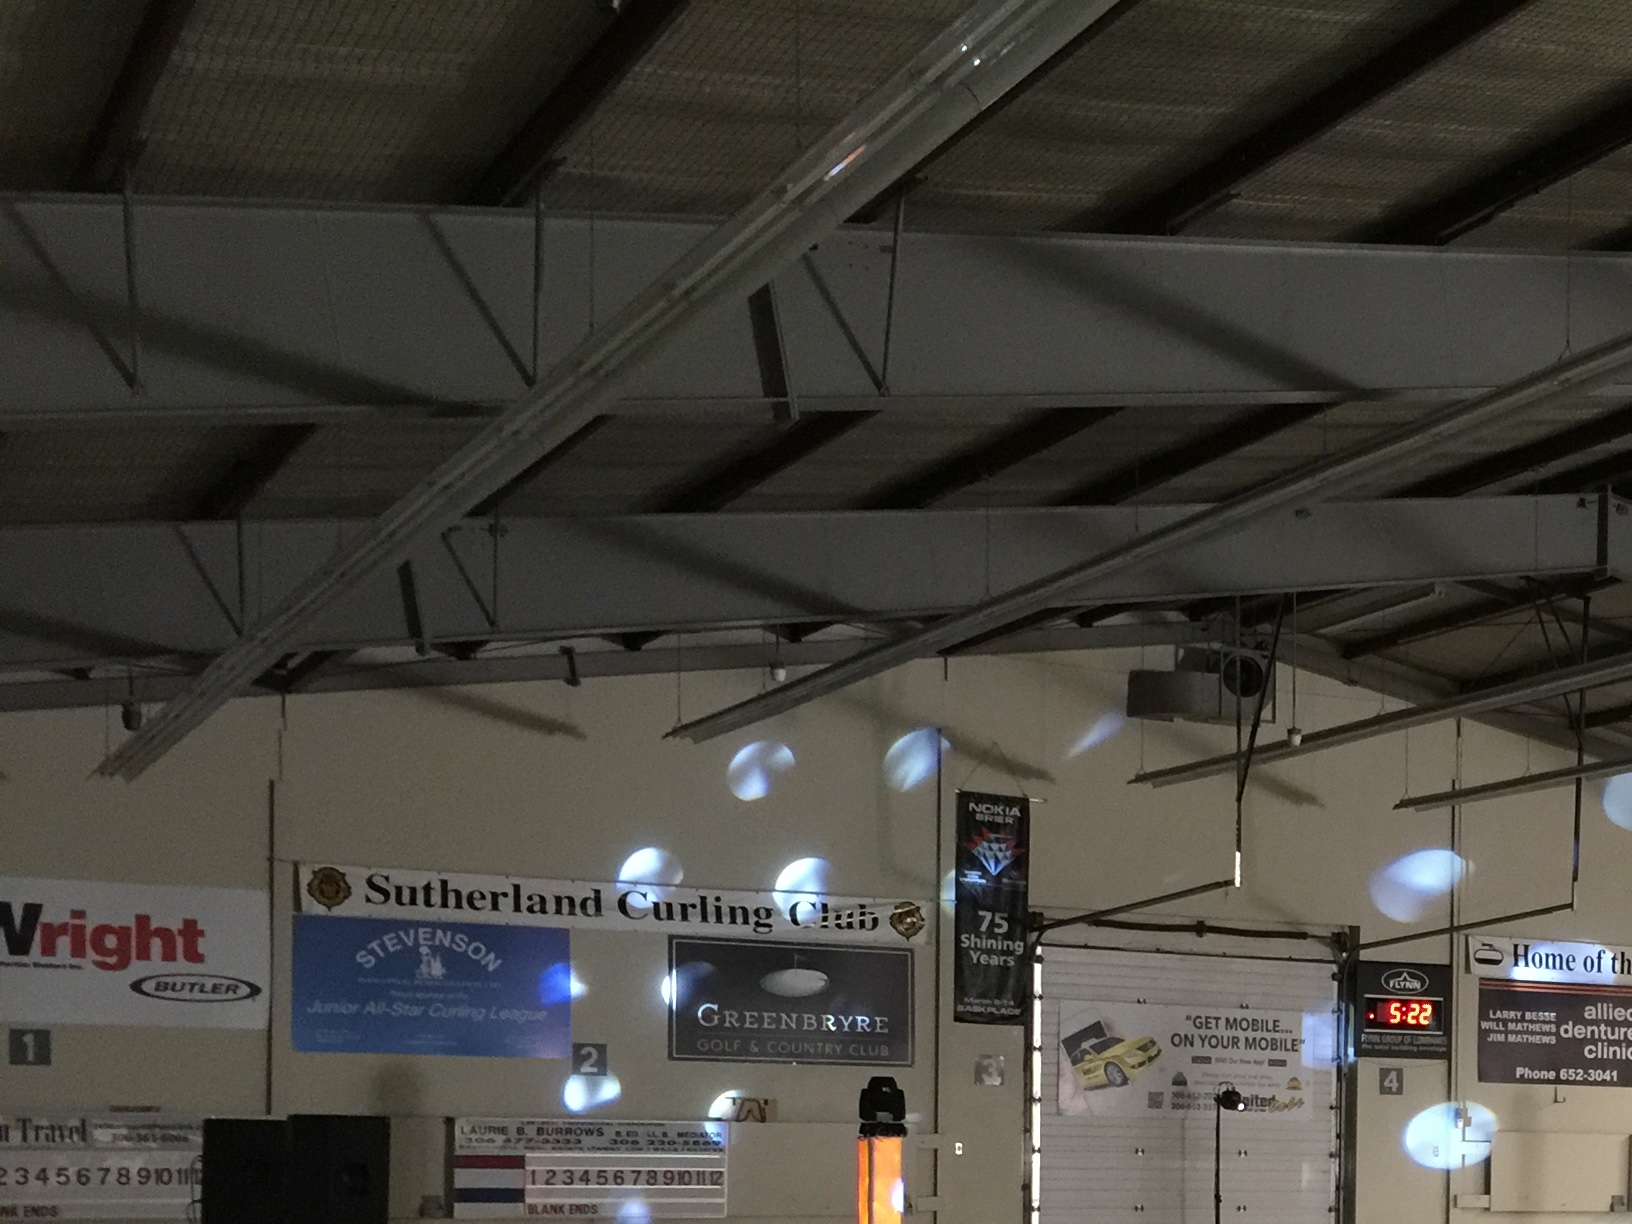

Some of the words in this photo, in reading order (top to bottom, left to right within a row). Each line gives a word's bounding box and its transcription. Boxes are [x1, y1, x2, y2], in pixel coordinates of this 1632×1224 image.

[968, 802, 1021, 817] NOKIA
[975, 813, 1014, 824] BRIER
[364, 872, 604, 918] Sutherland
[616, 890, 773, 934] Curling
[788, 900, 879, 931] Club
[978, 911, 1009, 933] 75
[355, 927, 502, 972] STEVENSON
[960, 934, 1024, 954] Shining
[969, 950, 1015, 966] Years
[1512, 943, 1575, 970] Home
[1583, 949, 1606, 972] of
[154, 981, 241, 995] BUTLER
[1389, 979, 1421, 990] FLYNN
[307, 1000, 358, 1014] Junior
[363, 1002, 425, 1017] All-Star
[428, 1003, 487, 1021] Curling
[490, 1006, 548, 1023] League
[697, 1003, 889, 1034] GREENBRYRE
[1390, 1002, 1433, 1025] 5:22
[1490, 1009, 1523, 1019] LARRY
[1525, 1011, 1556, 1021] BESSE
[1481, 1021, 1505, 1031] WILL
[1508, 1022, 1556, 1034] MATHEWS
[23, 1032, 36, 1062] 1
[1170, 1033, 1195, 1048] ON
[1199, 1035, 1241, 1050] YOUR
[1487, 1033, 1505, 1042] JIM
[1508, 1034, 1556, 1045] MATHEWS
[697, 1040, 741, 1053] GOLF
[749, 1041, 761, 1054] &
[767, 1041, 843, 1056] COUNTRY
[849, 1043, 889, 1057] CLUB
[580, 1046, 599, 1073] 2
[1383, 1070, 1399, 1093] 4
[1516, 1067, 1556, 1080] Phone
[1559, 1069, 1618, 1082] 652-3041
[461, 1126, 509, 1136] LAURIE
[516, 1127, 529, 1137] B.
[536, 1127, 606, 1138] BURROWS
[15, 1167, 30, 1186] 3
[35, 1167, 50, 1186] 4
[55, 1167, 71, 1186] 5
[76, 1167, 91, 1186] 6
[97, 1167, 111, 1186] 7
[117, 1167, 131, 1186] 8
[137, 1167, 152, 1186] 9
[155, 1167, 174, 1186] 10
[530, 1170, 536, 1187] 1
[545, 1170, 557, 1187] 2
[562, 1170, 574, 1187] 3
[578, 1170, 591, 1187] 4
[596, 1170, 608, 1187] 5
[613, 1170, 625, 1187] 6
[630, 1170, 641, 1187] 7
[645, 1170, 657, 1187] 8
[663, 1170, 675, 1187] 9
[677, 1170, 692, 1187] 10
[695, 1170, 707, 1187] 11
[709, 1170, 724, 1187] 12
[23, 1205, 59, 1218] ENDS
[528, 1203, 566, 1216] BLANK
[569, 1204, 599, 1216] ENDS
